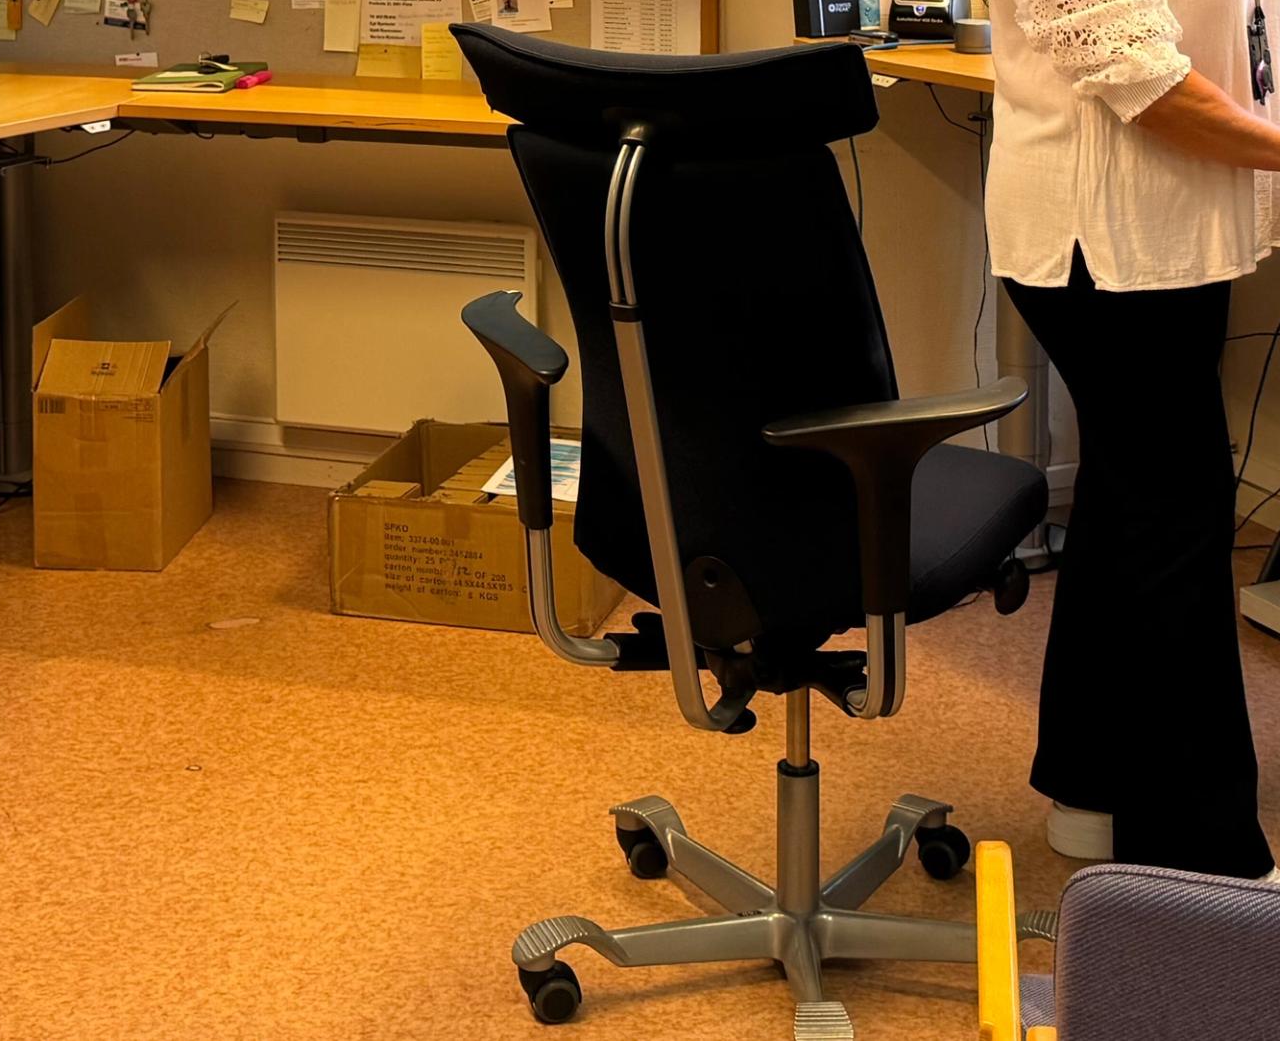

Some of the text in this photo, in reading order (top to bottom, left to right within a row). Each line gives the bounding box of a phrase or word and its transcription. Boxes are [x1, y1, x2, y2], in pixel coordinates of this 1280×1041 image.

[384, 544, 406, 552] order
[384, 563, 412, 572] carton
[384, 582, 412, 594] weight
